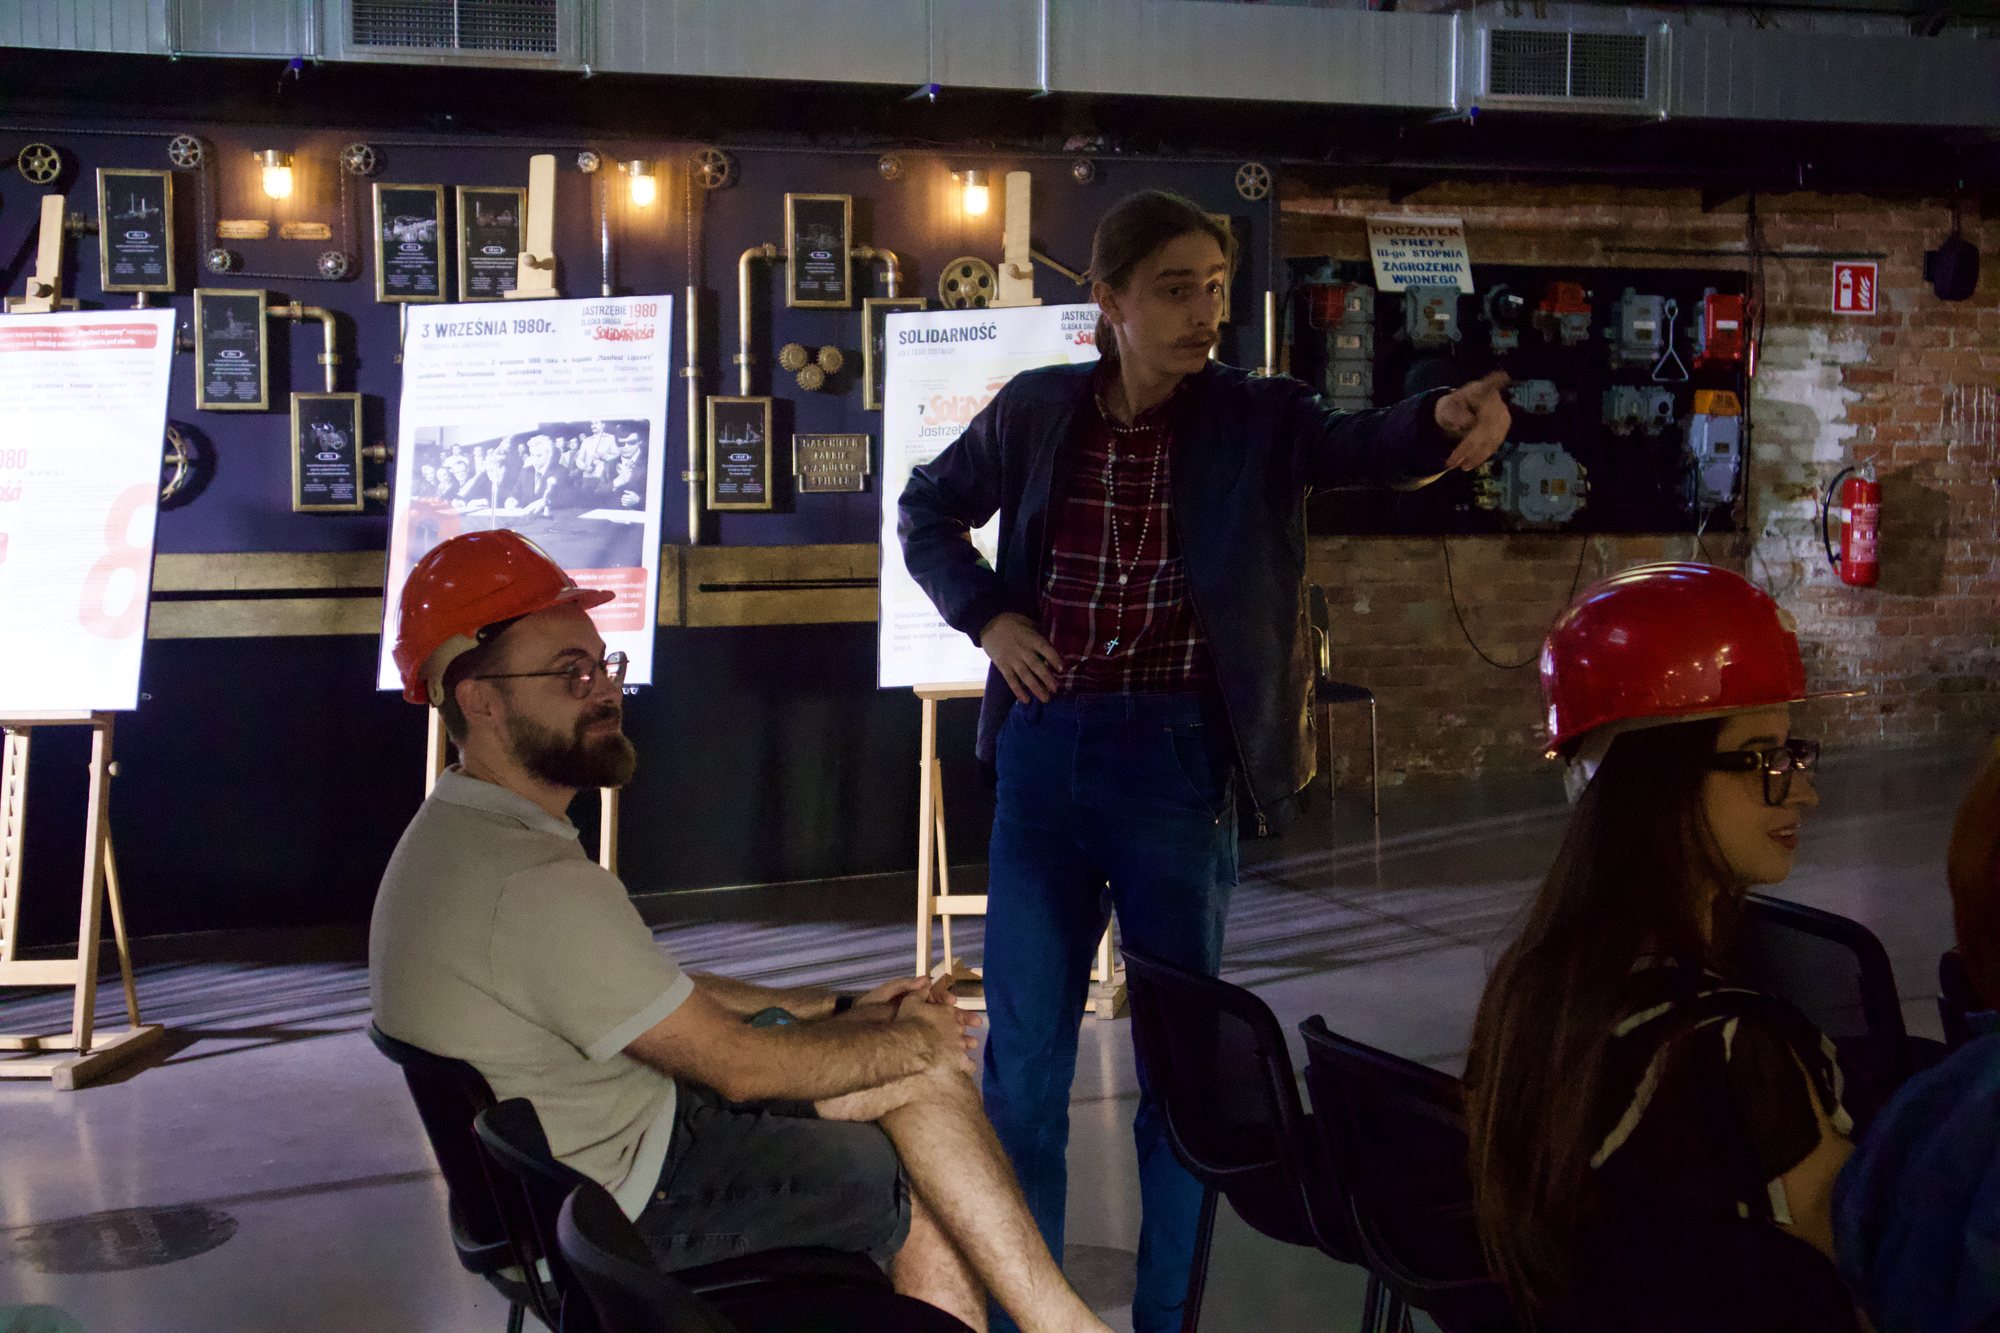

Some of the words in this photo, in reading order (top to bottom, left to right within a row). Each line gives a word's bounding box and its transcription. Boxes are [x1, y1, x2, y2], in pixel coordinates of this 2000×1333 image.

[1390, 238, 1446, 247] STREFY
[1377, 250, 1406, 258] III-go
[1412, 250, 1463, 258] STOPNIA
[1392, 274, 1458, 284] WODNEGO
[581, 305, 627, 317] JASTRZĘBIE
[630, 303, 657, 318] 1980
[422, 324, 430, 338] 3
[435, 317, 508, 338] WRZEŚNIA
[512, 318, 556, 334] 1980r.
[898, 322, 997, 345] SOLIDARNOŚĆ
[918, 404, 925, 415] 7
